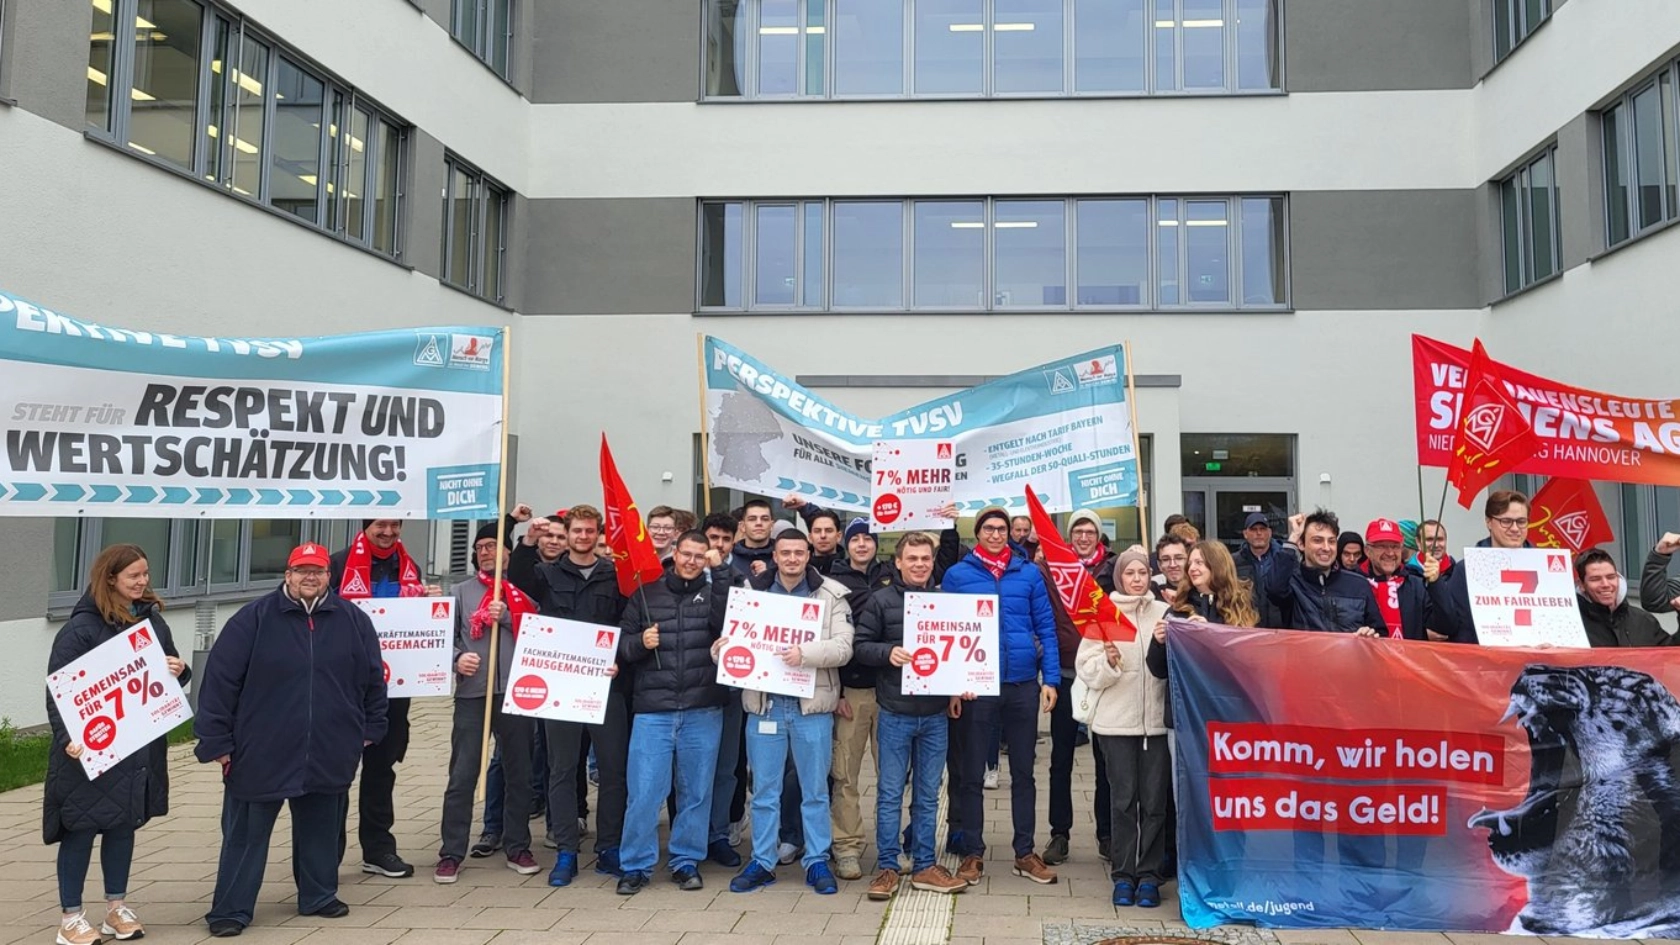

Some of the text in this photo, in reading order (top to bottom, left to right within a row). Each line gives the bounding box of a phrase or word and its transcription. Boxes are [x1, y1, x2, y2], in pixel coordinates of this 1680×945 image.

[713, 347, 963, 437] PERSPEKTIVE TVSV
[11, 383, 445, 438] STEHT FÜR RESPEKT UND
[988, 437, 1024, 453] ENTGELT
[1025, 430, 1047, 445] NACH
[1047, 423, 1070, 439] TARIF
[1071, 415, 1103, 432] BAYERN
[1633, 421, 1680, 456] AG
[7, 428, 407, 482] WERTSCHÄTZUNG!
[792, 432, 852, 468] UNSERE
[793, 448, 835, 468] FÜR ALLE
[991, 442, 1072, 471] 35-STUNDEN-WOCHE
[1553, 443, 1641, 466] HANNOVER
[991, 468, 1029, 484] WEGFALL
[1030, 464, 1047, 476] DER
[1048, 444, 1131, 472] 50-QUALI-STUNDEN
[439, 477, 483, 490] NICHT OHNE
[906, 468, 951, 485] MEHR
[1080, 472, 1124, 488] NICHT OHNE
[447, 490, 475, 506] DICH
[896, 486, 917, 494] NÖTIG
[933, 485, 951, 493] FAIR!
[1090, 482, 1118, 499] DICH
[1475, 595, 1573, 607] ZUM FAIRLIEBEN
[378, 629, 445, 639] KRÄFTEMANGEL?!
[763, 625, 816, 645] MEHR
[917, 621, 982, 632] GEMEINSAM
[381, 638, 445, 650] SGEMACHT!
[750, 642, 774, 651] NÖTIG
[917, 632, 936, 644] FÜR
[523, 647, 607, 666] FACHKRÄFTEMANGEL?!
[520, 657, 605, 677] HAUSGEMACHT!
[73, 656, 147, 707] GEMEINSAM
[79, 700, 103, 720] FÜR
[1213, 731, 1494, 773] Komm, wir holen
[1214, 790, 1439, 824] uns das Geld!
